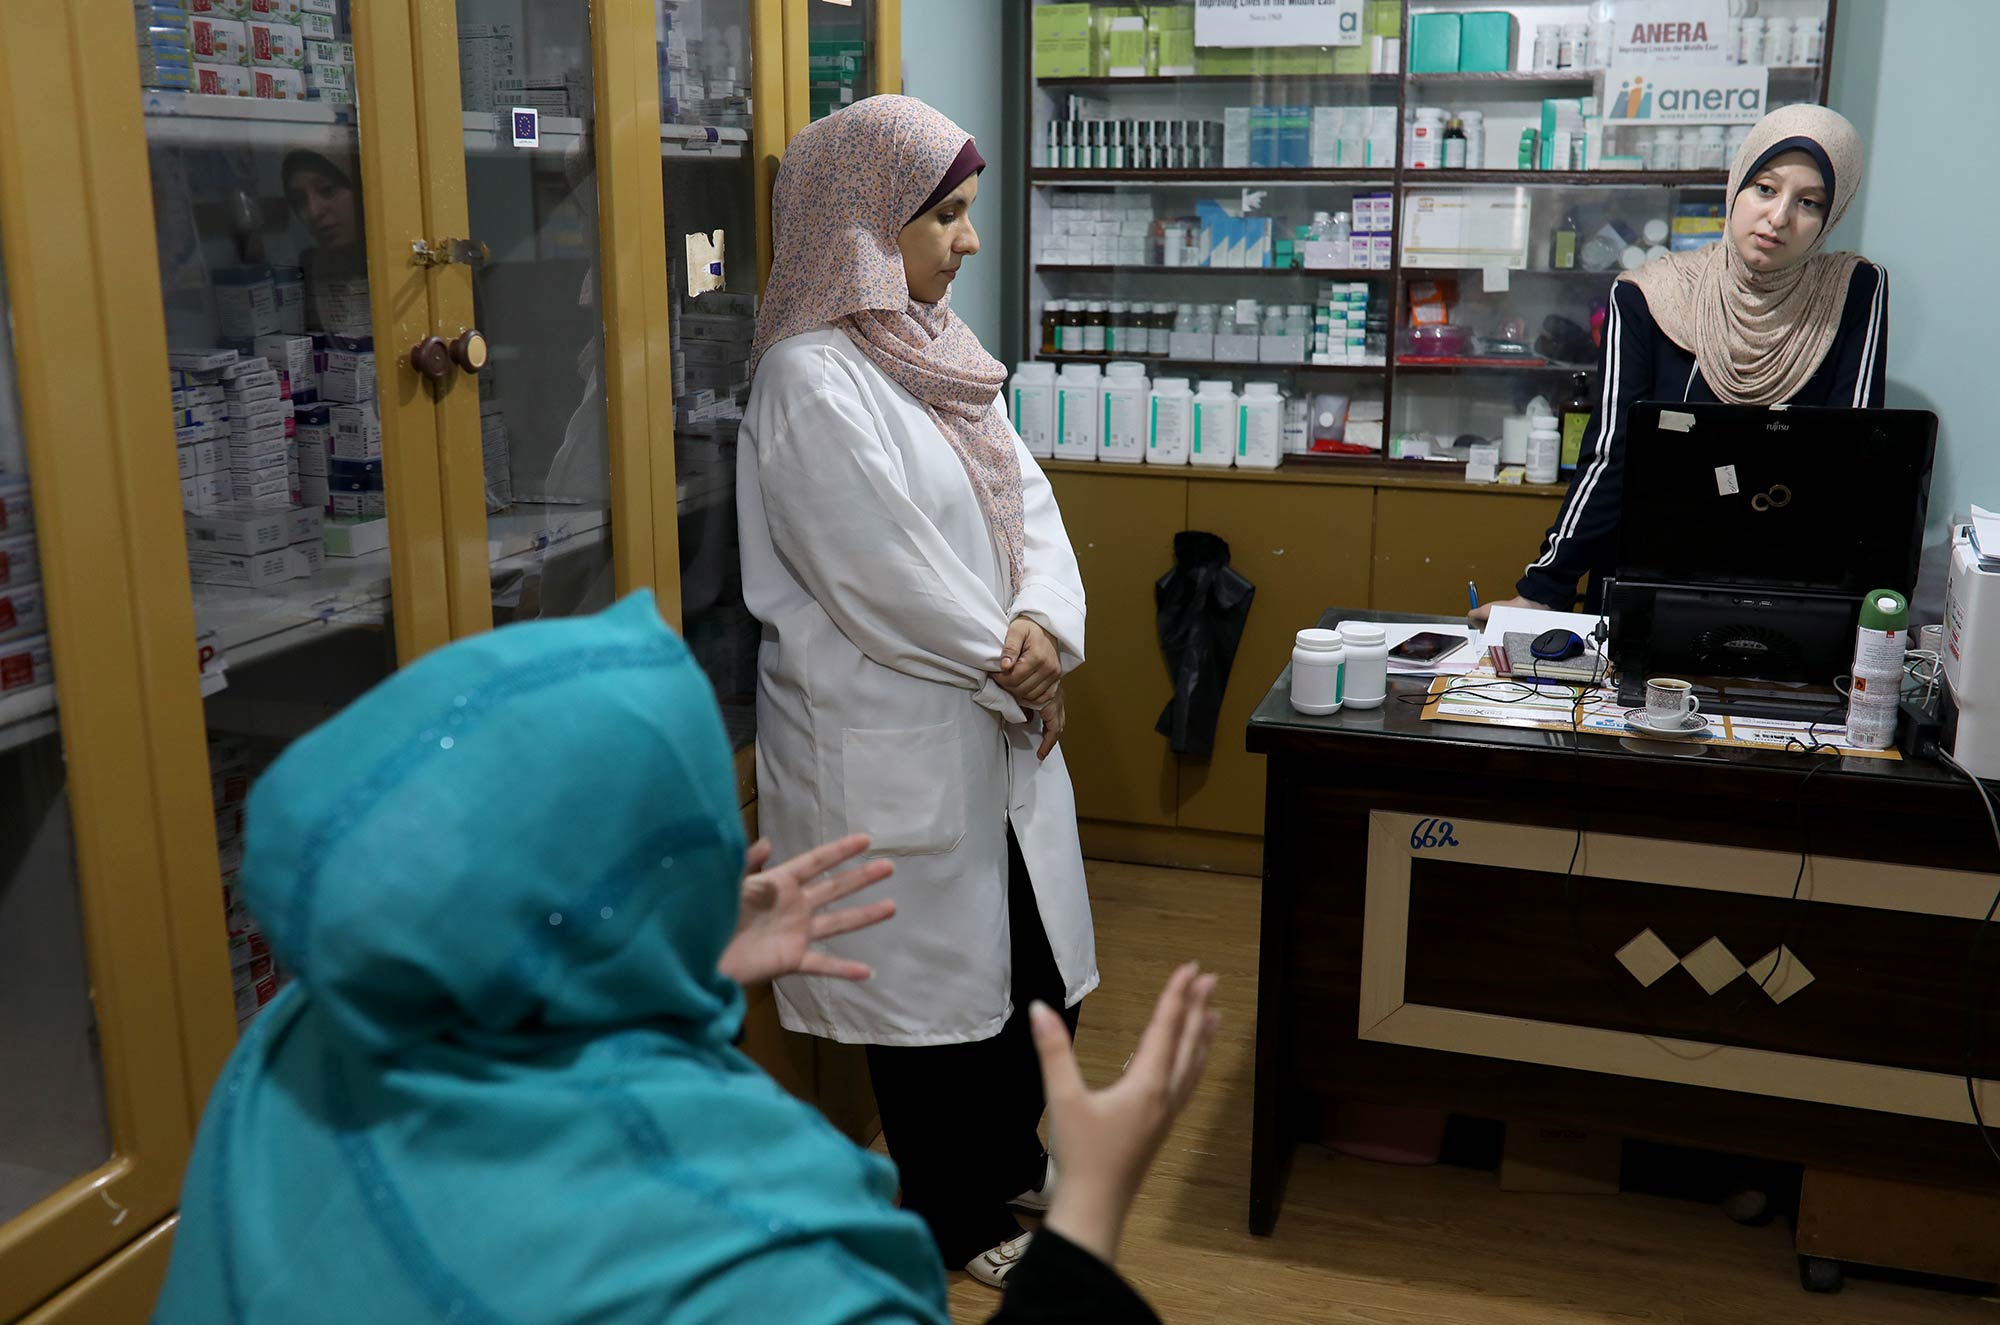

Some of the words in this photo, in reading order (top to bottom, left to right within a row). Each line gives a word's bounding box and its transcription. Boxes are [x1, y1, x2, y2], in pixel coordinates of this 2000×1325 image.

[1631, 21, 1708, 44] ANERA
[1658, 88, 1760, 111] anera
[1766, 422, 1790, 432] FUJITSU
[1411, 818, 1459, 849] 662
